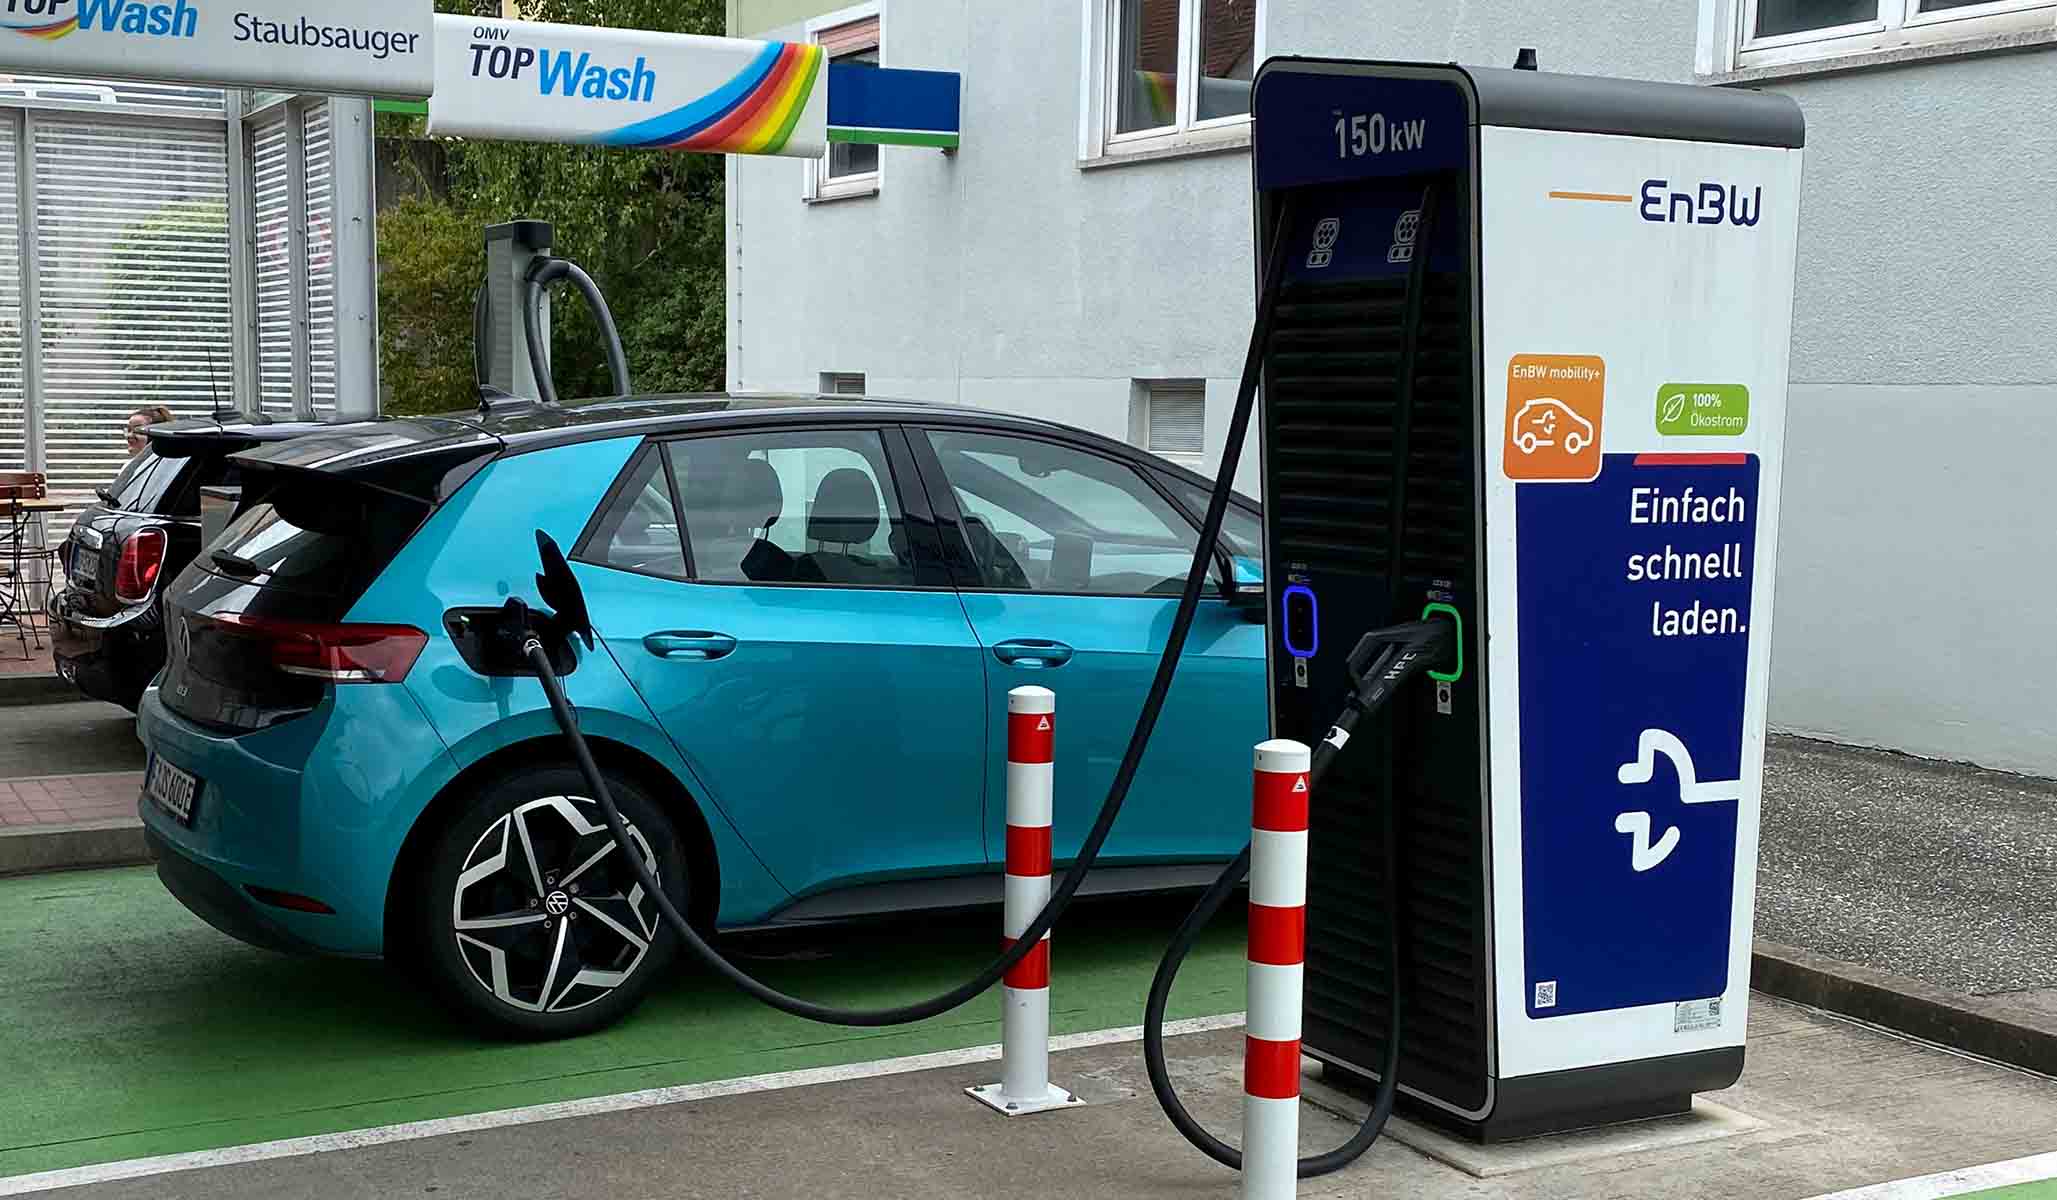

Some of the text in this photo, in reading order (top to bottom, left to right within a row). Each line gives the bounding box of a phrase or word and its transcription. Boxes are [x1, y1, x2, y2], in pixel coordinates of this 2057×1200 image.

[76, 0, 198, 37] Wash
[233, 12, 420, 59] Staubsauger
[473, 25, 510, 41] OMV
[470, 43, 656, 103] TOP Wash
[1334, 112, 1425, 158] 150 kW
[1640, 178, 1762, 227] EnBW
[1512, 365, 1547, 379] EnBW
[1692, 392, 1722, 408] 100%
[1630, 486, 1746, 524] Einfach
[1626, 542, 1743, 581] schnell
[1652, 599, 1747, 636] laden.
